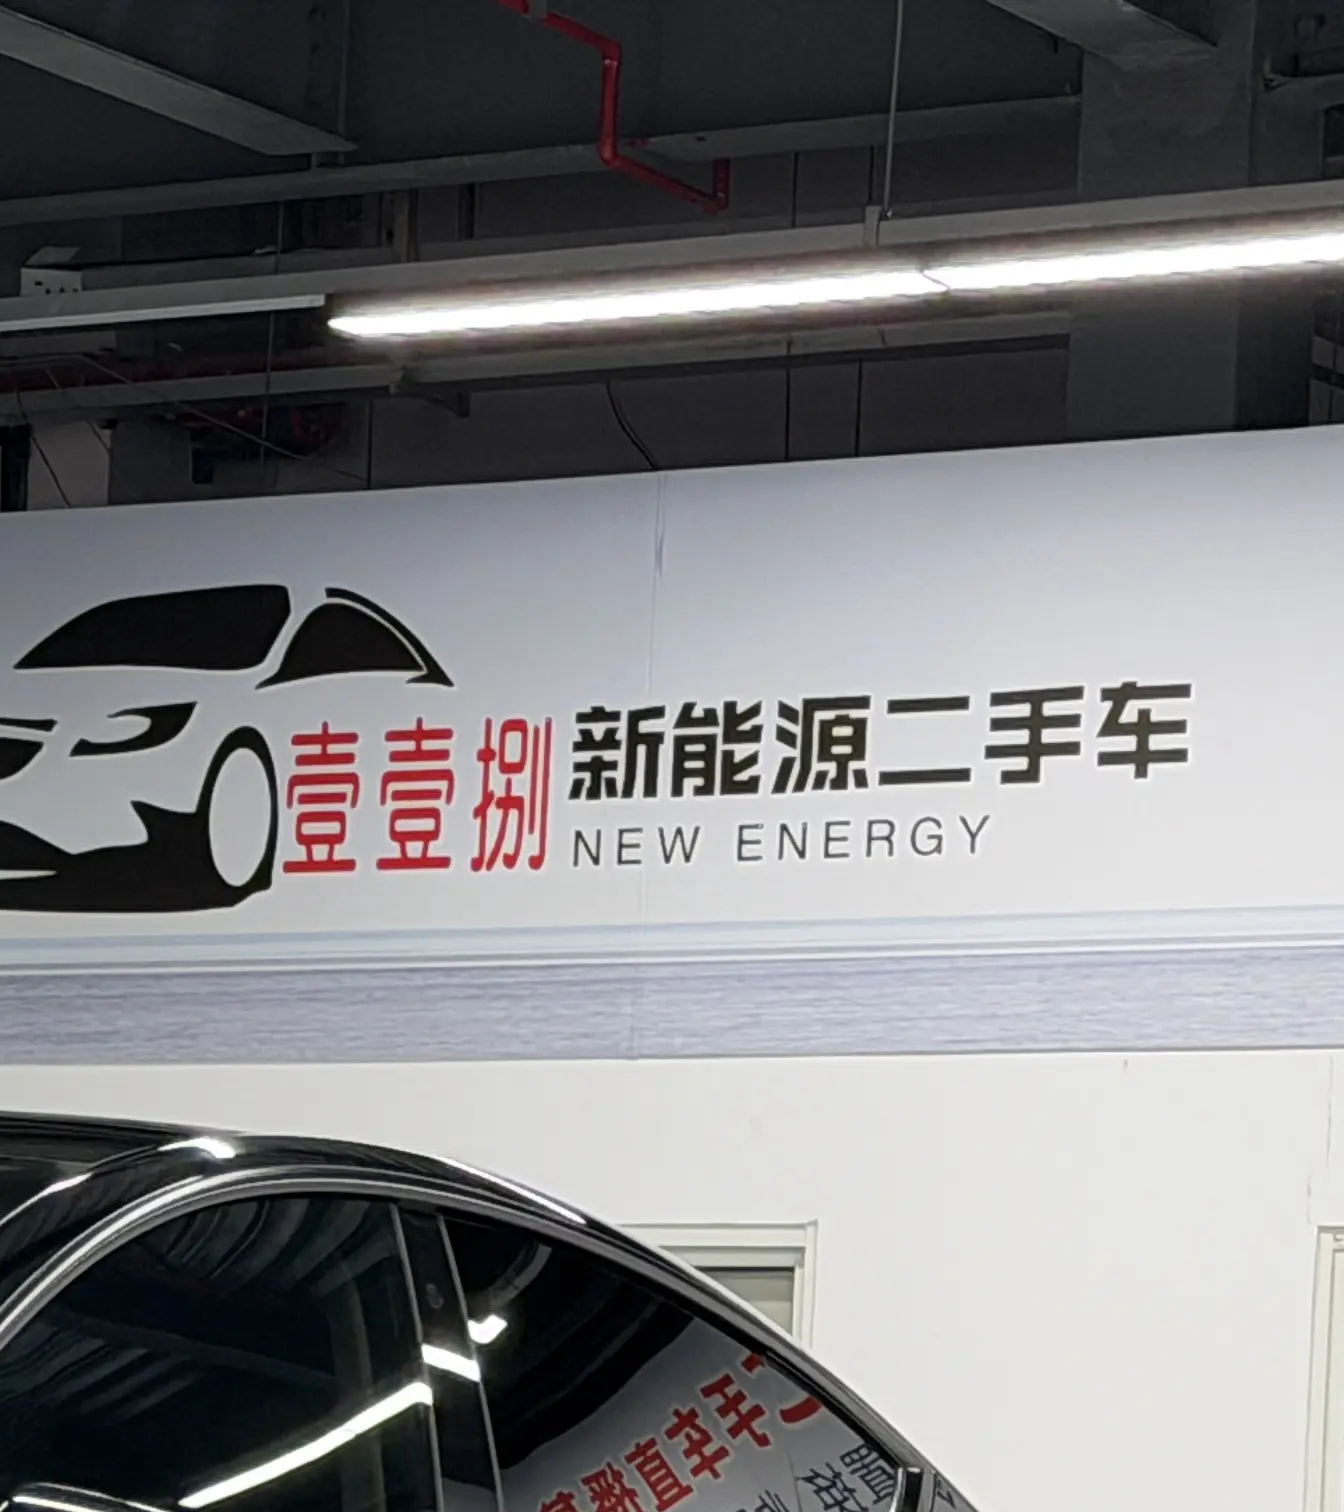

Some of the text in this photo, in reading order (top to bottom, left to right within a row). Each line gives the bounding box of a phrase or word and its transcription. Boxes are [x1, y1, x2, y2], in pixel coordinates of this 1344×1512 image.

[568, 681, 1193, 801] 新能源二手车
[572, 814, 992, 868] NEW ENERGY
